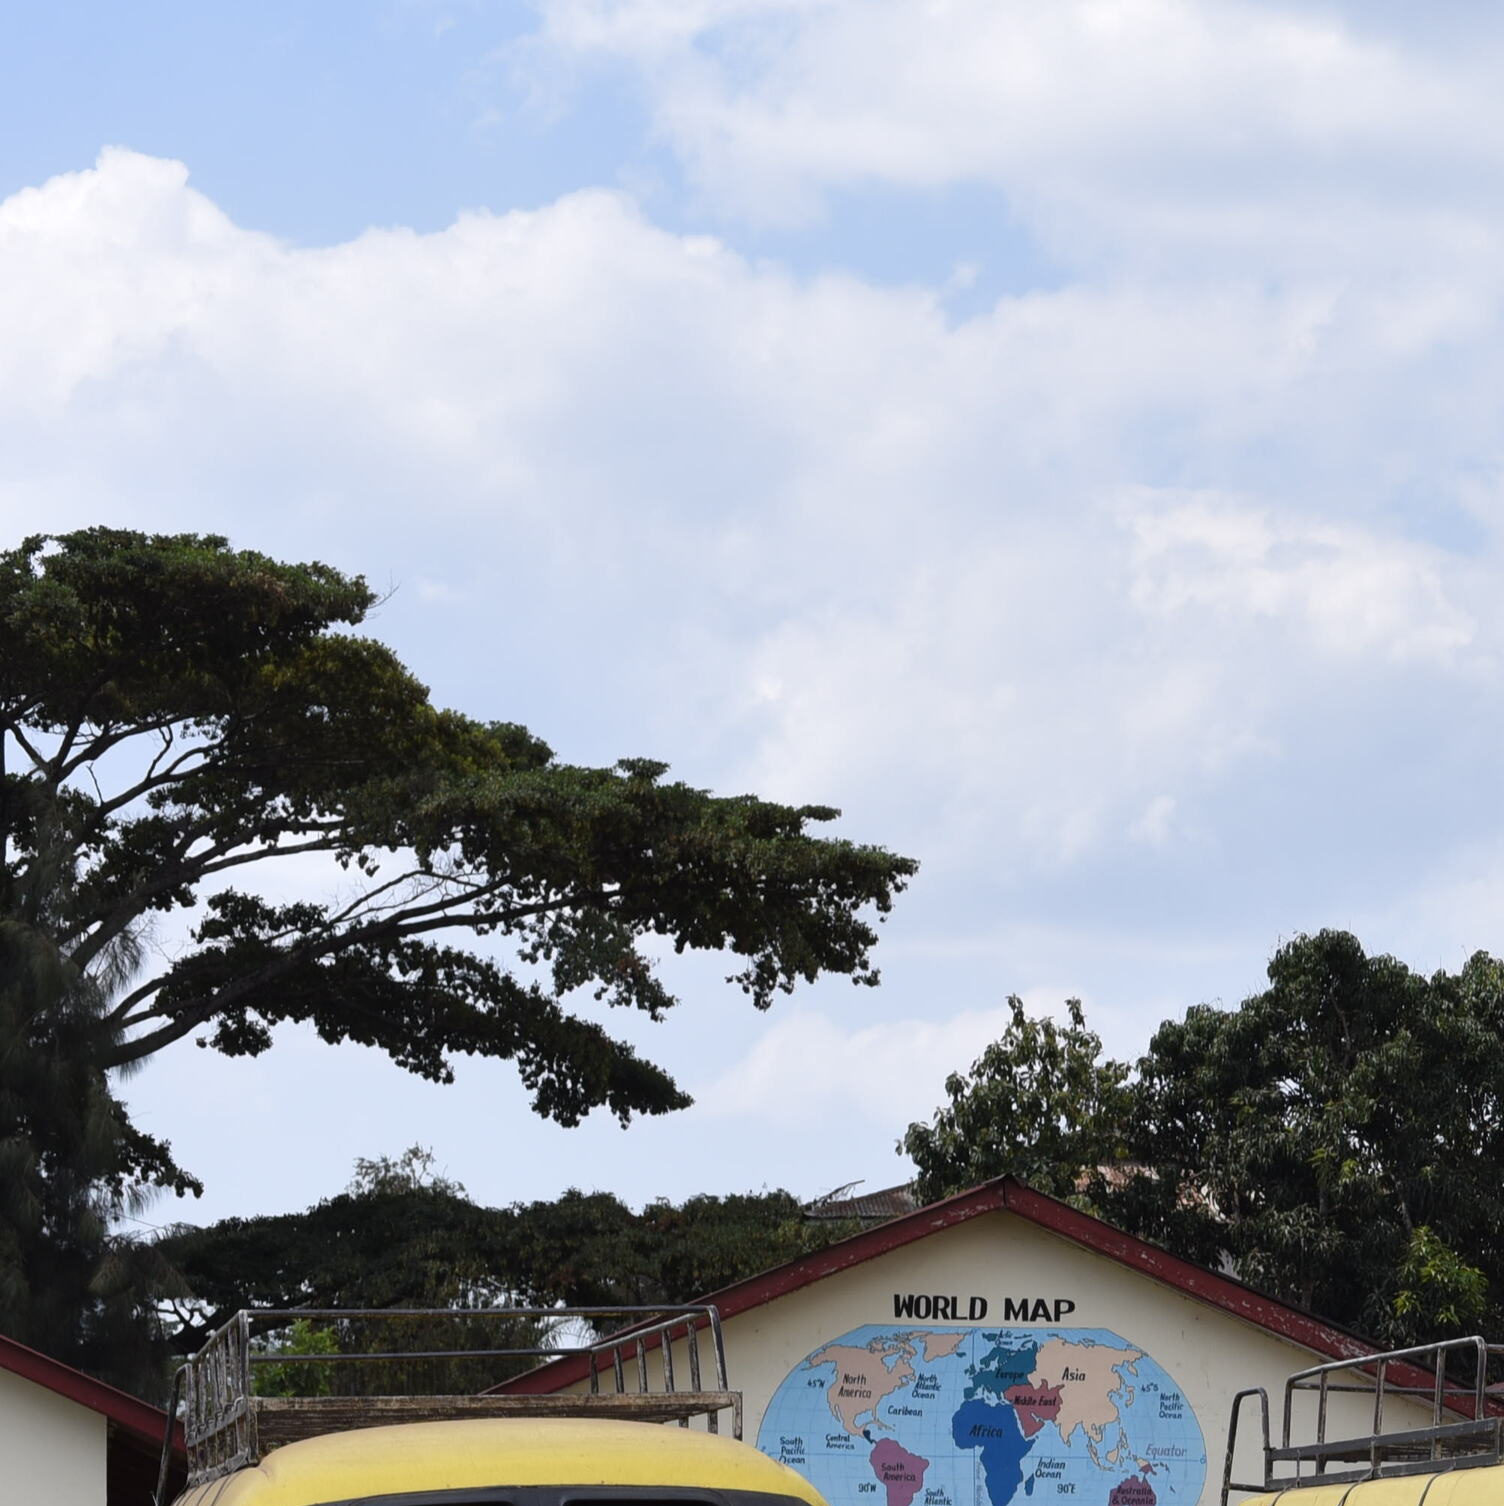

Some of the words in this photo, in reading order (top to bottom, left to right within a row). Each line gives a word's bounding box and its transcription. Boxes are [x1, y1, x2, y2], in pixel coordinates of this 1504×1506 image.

[894, 1294, 988, 1320] WORLD
[1004, 1297, 1075, 1322] MAP
[843, 1374, 867, 1386] North
[917, 1374, 938, 1383] North
[995, 1368, 1025, 1382] Europe
[1062, 1367, 1086, 1382] Asia
[838, 1386, 872, 1399] America
[914, 1382, 941, 1392] Atlantic
[911, 1390, 936, 1400] Ocean
[1159, 1393, 1180, 1402] North
[1038, 1396, 1057, 1407] East
[1159, 1402, 1183, 1411] Pacific
[887, 1406, 923, 1417] Caribean
[1158, 1411, 1183, 1420] Ocean
[969, 1424, 1003, 1438] Africa
[779, 1436, 803, 1446] South
[825, 1433, 850, 1443] Central
[780, 1445, 805, 1456] Pacific
[825, 1441, 855, 1450] America
[1146, 1444, 1187, 1459] Equator
[881, 1462, 905, 1471] South
[1037, 1457, 1066, 1470] Indian
[883, 1472, 916, 1482] America
[1035, 1469, 1062, 1480] Ocean
[925, 1488, 944, 1497] South
[1057, 1482, 1076, 1494] 90°E
[1116, 1485, 1152, 1496] Australia
[924, 1496, 952, 1506] Atlantic
[1121, 1494, 1154, 1506] Oceania
